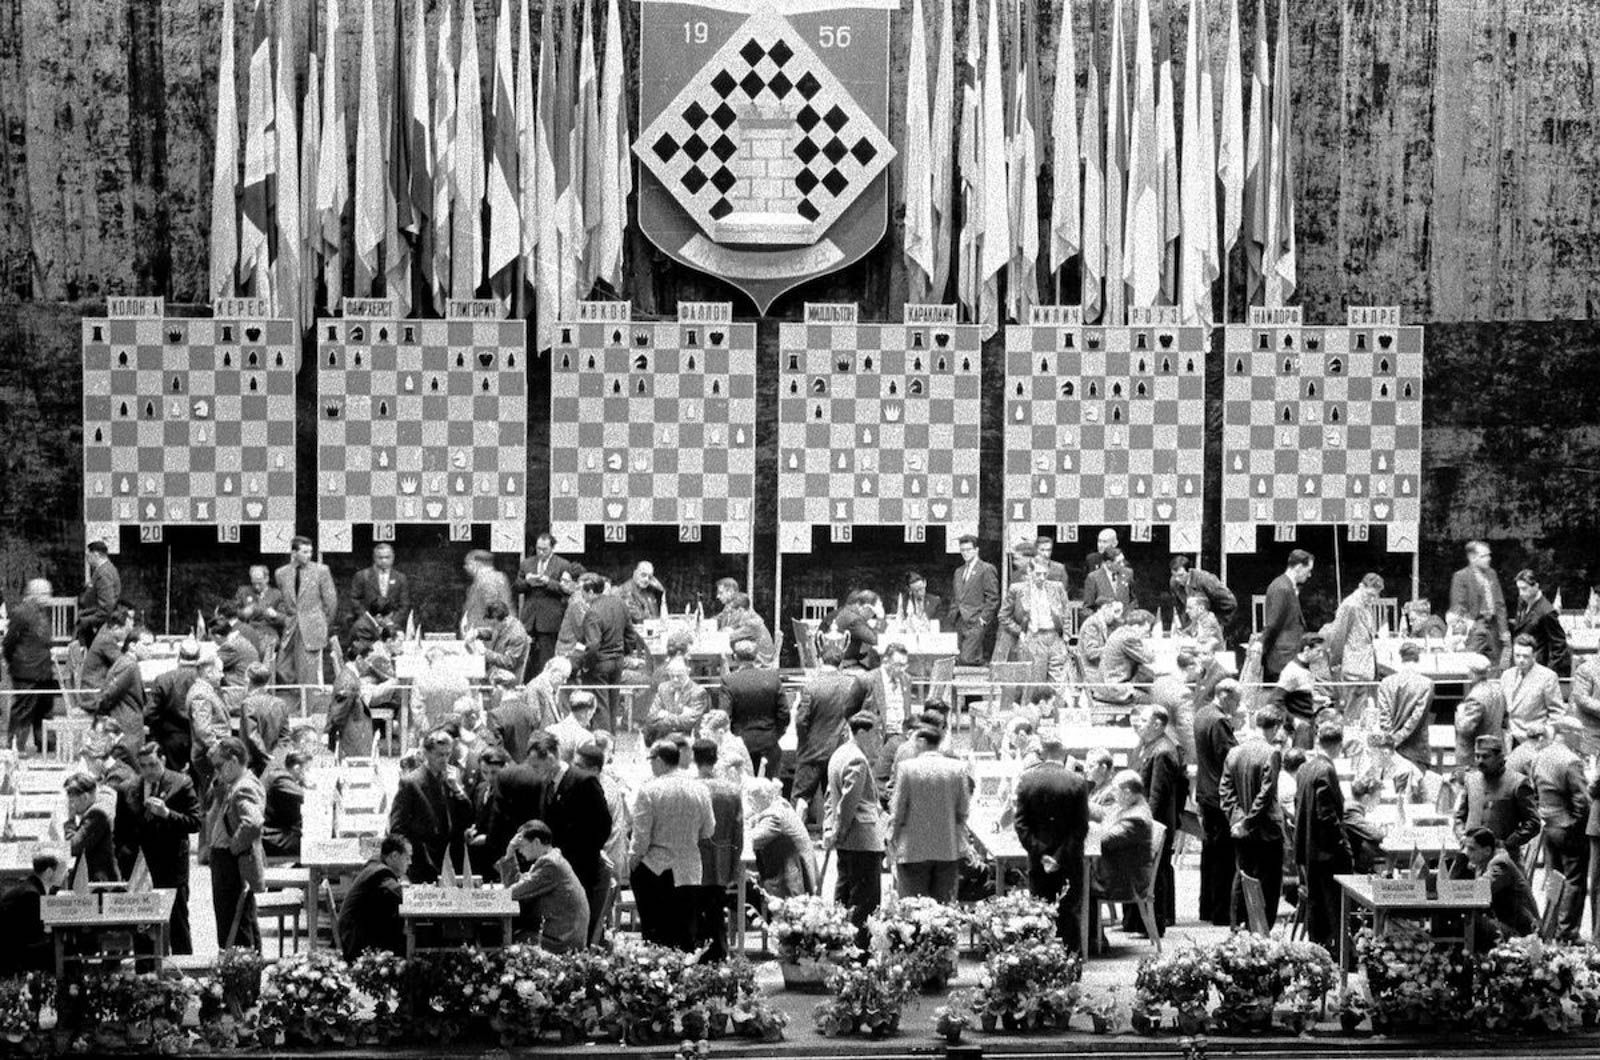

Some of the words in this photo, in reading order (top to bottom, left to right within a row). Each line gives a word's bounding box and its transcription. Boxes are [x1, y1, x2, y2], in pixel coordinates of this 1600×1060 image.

[684, 21, 708, 44] 19
[819, 25, 851, 48] 56
[217, 300, 264, 316] КЕРЕС
[580, 304, 626, 320] ИВКОВ
[142, 526, 160, 540] 20
[222, 526, 238, 540] 19
[377, 524, 393, 539] 13
[454, 524, 470, 539] 12
[606, 525, 624, 540] 20
[681, 525, 699, 540] 20
[834, 525, 850, 540] 16
[908, 525, 924, 540] 16
[1060, 525, 1076, 540] 15
[1134, 525, 1150, 540] 14
[1278, 525, 1293, 540] 17
[1351, 525, 1367, 540] 16
